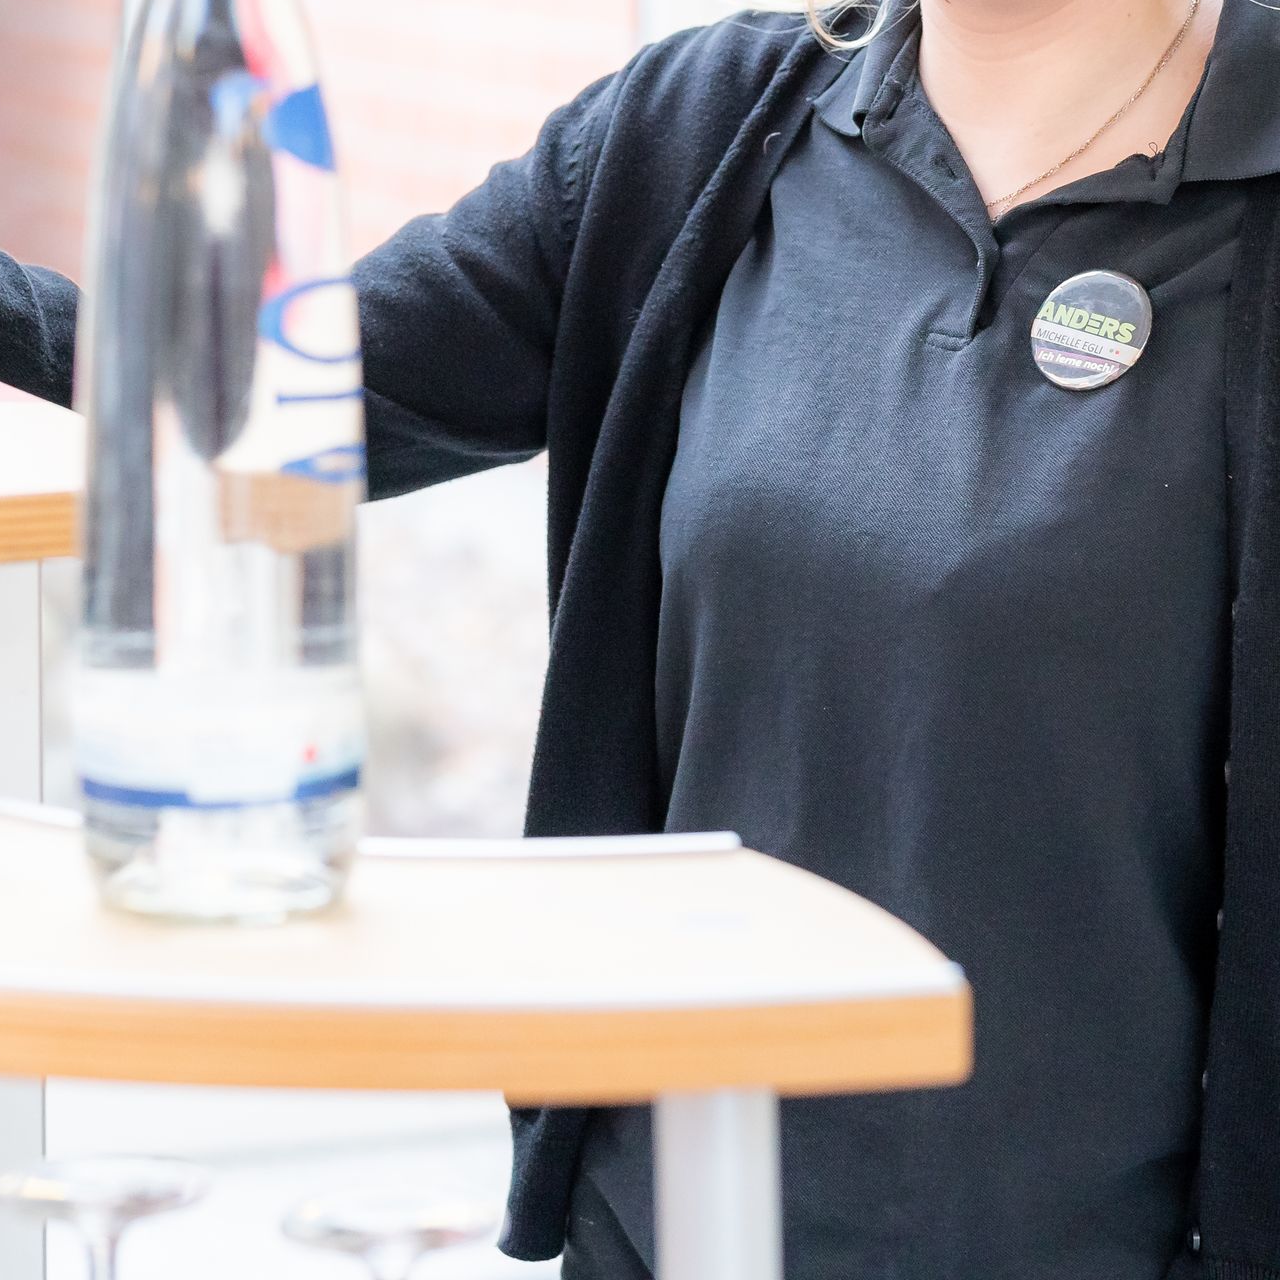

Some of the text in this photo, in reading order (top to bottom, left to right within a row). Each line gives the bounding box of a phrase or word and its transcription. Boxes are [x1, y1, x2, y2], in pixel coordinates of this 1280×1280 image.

[1037, 301, 1137, 344] ANDERS
[1036, 328, 1104, 355] MICHELLE EGLI
[1037, 350, 1055, 361] Ich
